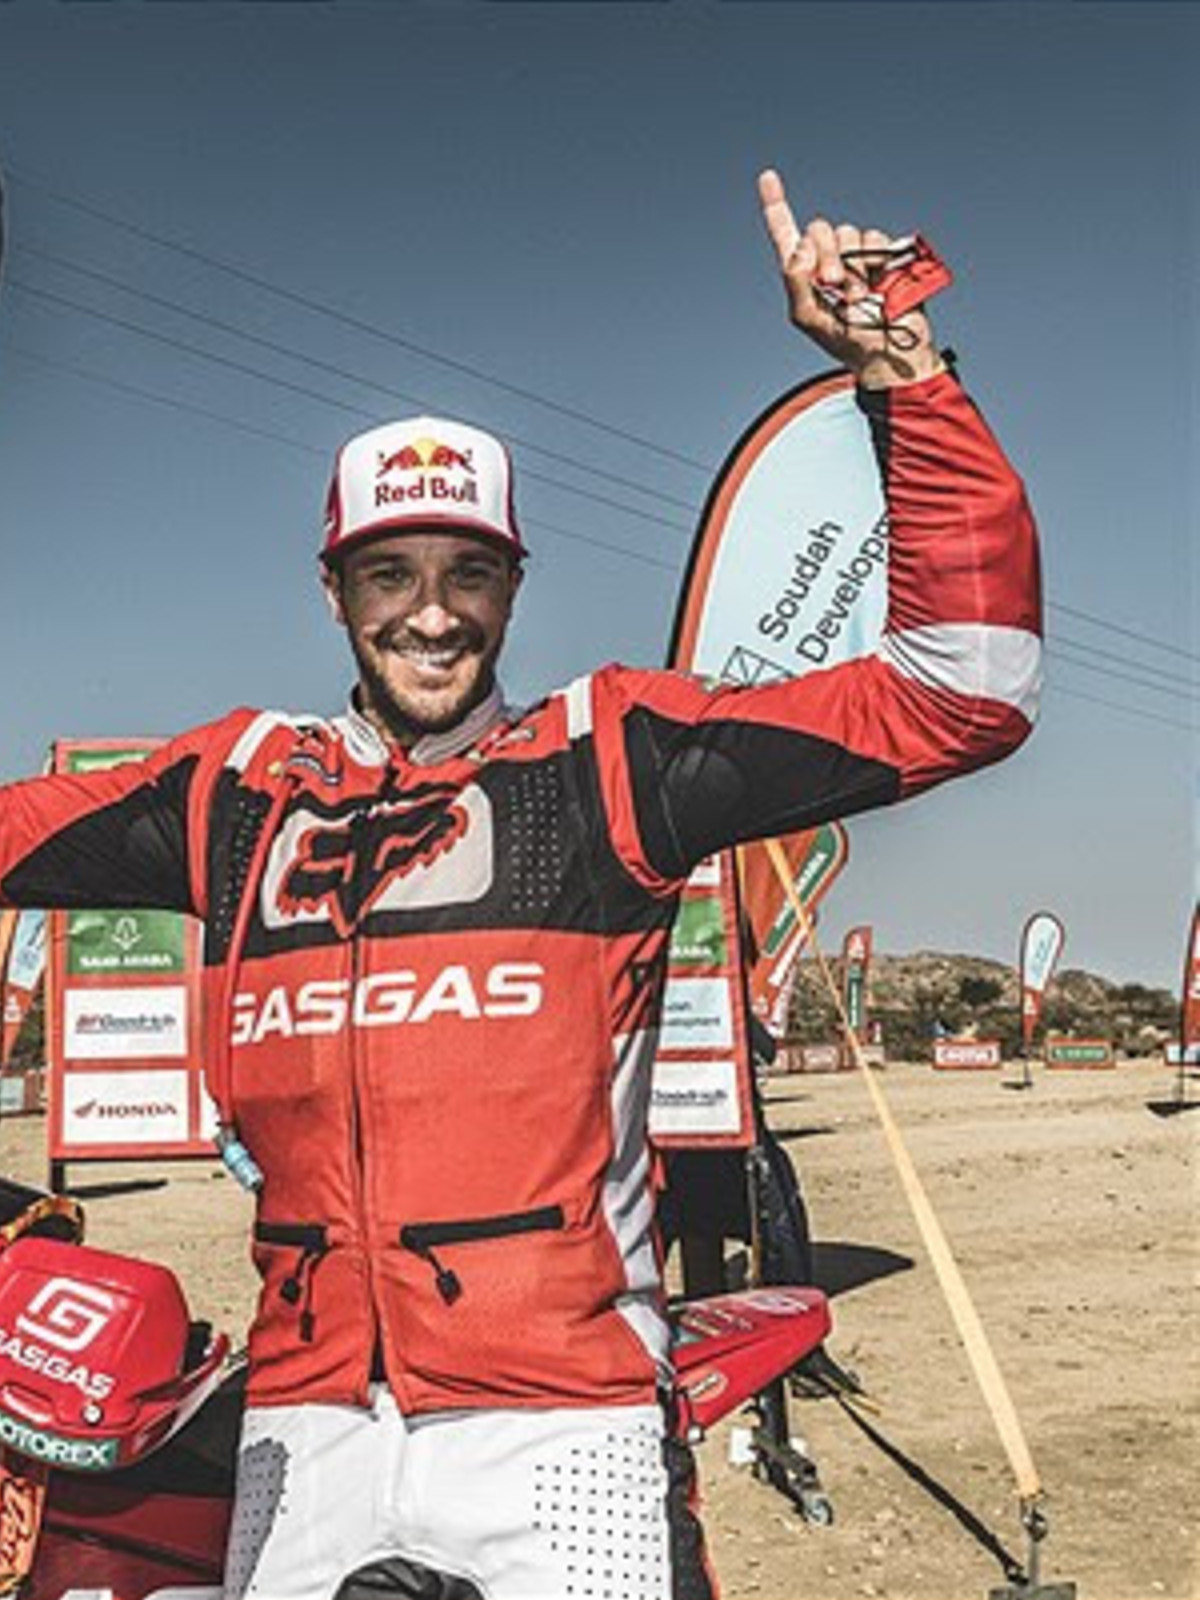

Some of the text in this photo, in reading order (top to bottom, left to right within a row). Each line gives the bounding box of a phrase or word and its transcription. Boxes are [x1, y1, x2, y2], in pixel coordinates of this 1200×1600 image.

[374, 474, 481, 507] Red Bull
[757, 520, 845, 643] Soudah
[97, 1102, 178, 1118] HONDA
